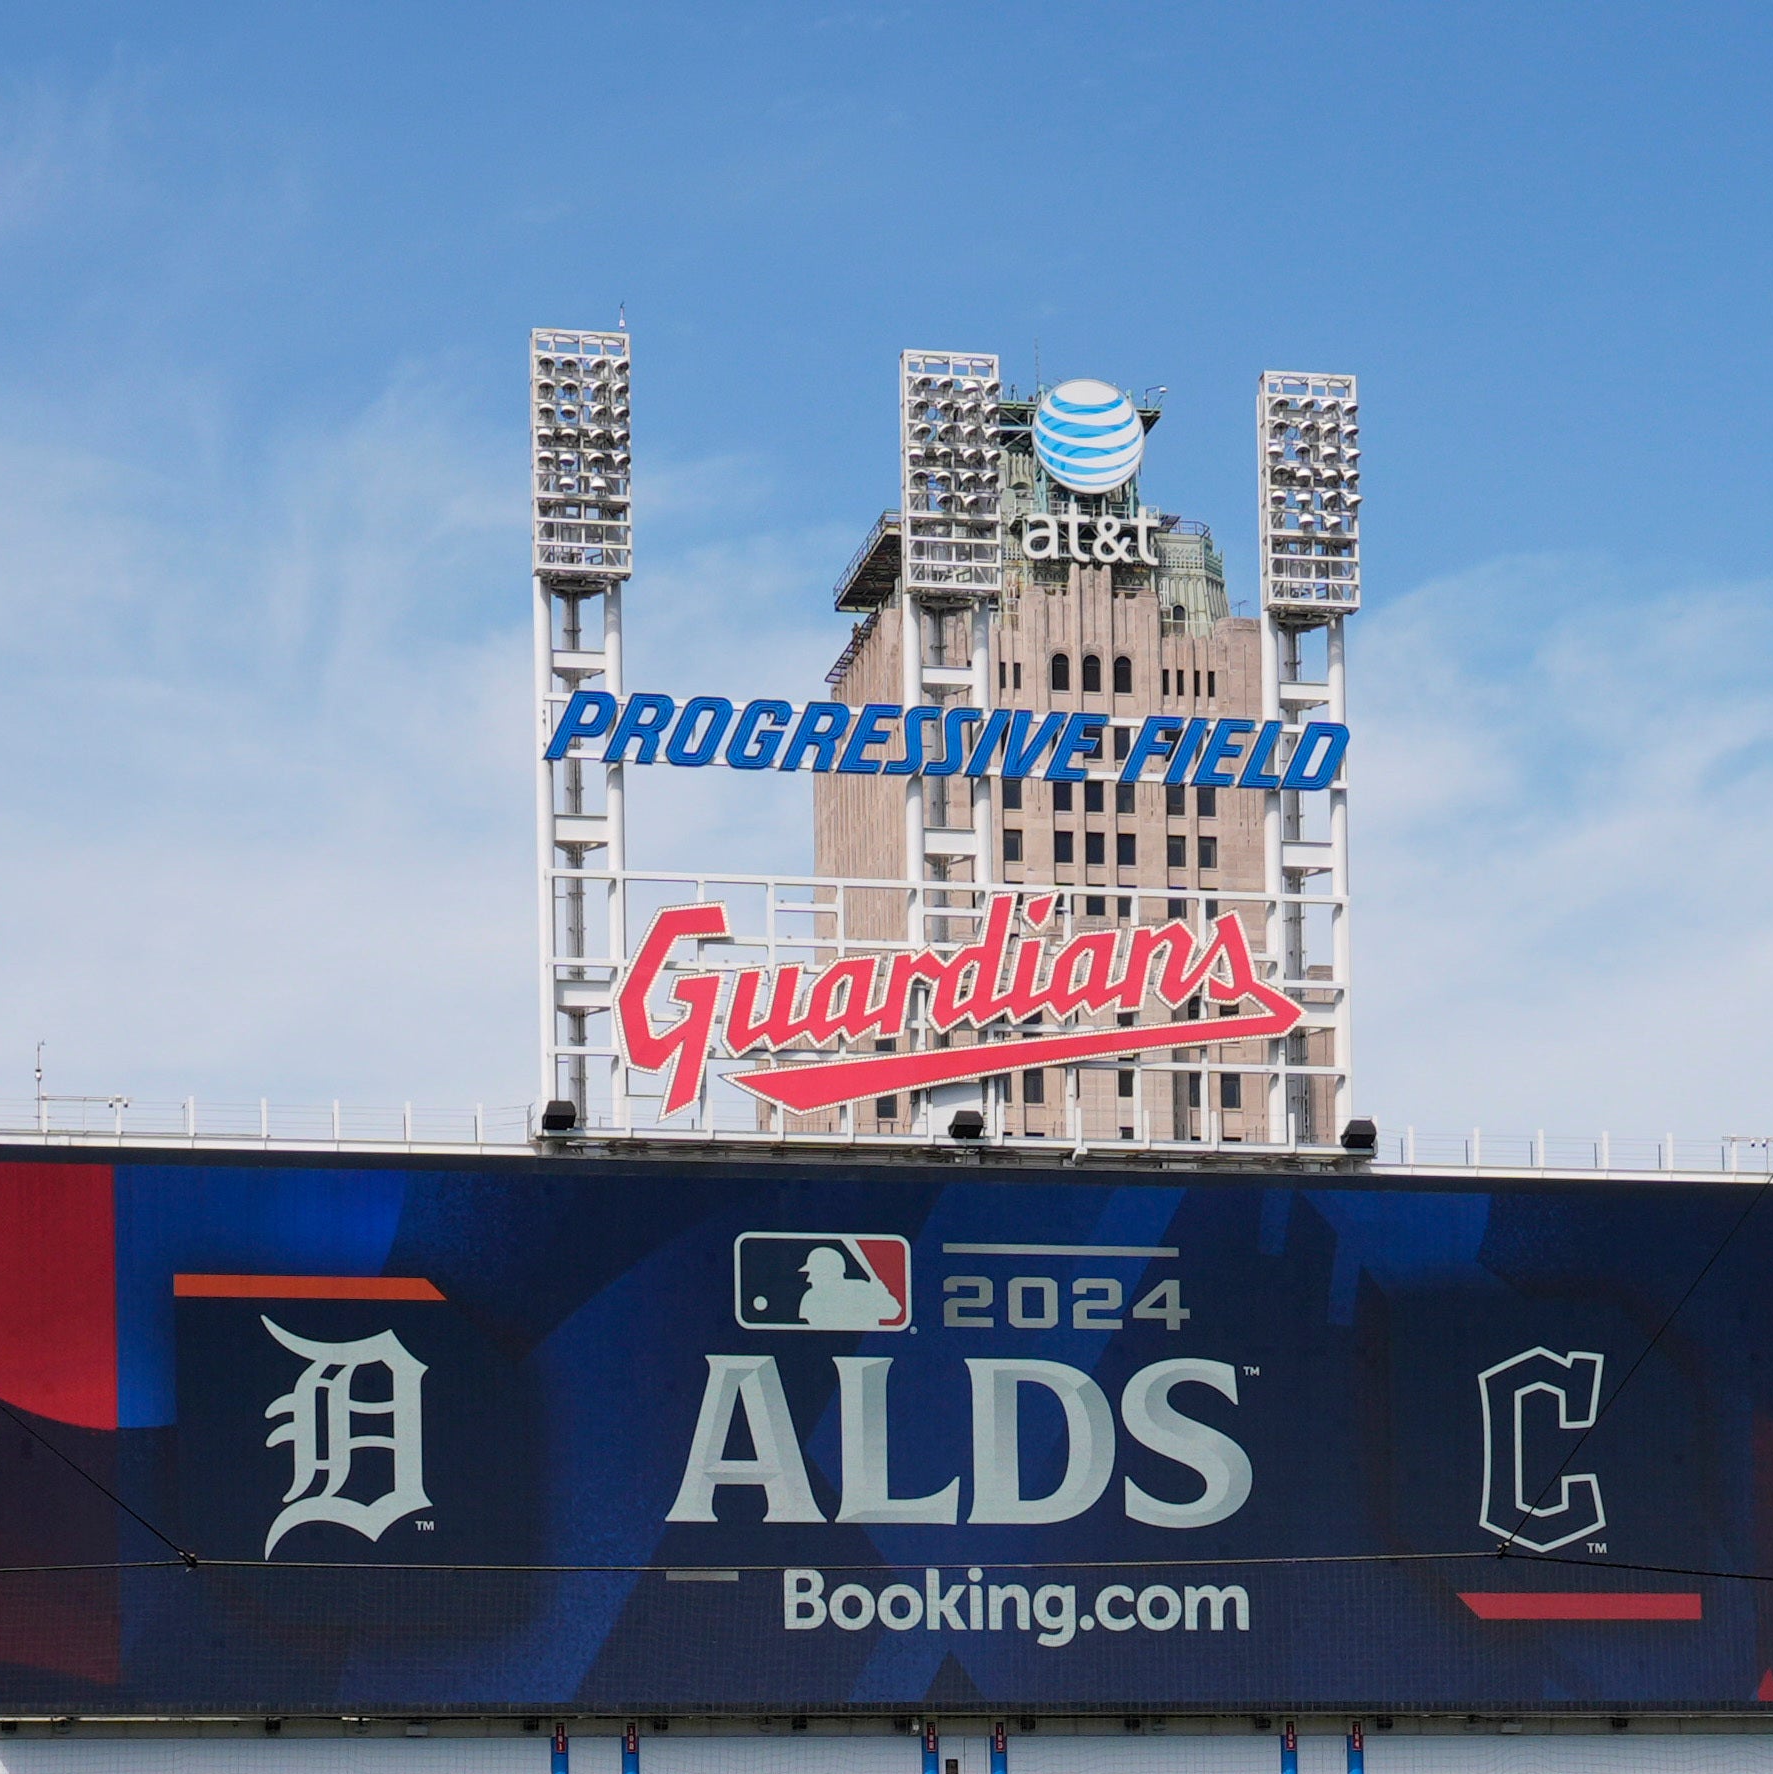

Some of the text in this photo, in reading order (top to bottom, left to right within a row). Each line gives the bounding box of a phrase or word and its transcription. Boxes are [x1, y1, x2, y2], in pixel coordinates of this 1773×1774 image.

[1022, 502, 1159, 568] at&t
[543, 690, 1352, 792] PROGRESSIVE FIELD
[614, 890, 1306, 1121] Guardians
[942, 1275, 1191, 1331] 2024
[664, 1354, 1253, 1529] ALDS
[1477, 1346, 1606, 1553] C
[783, 1566, 1250, 1647] Booking.com
